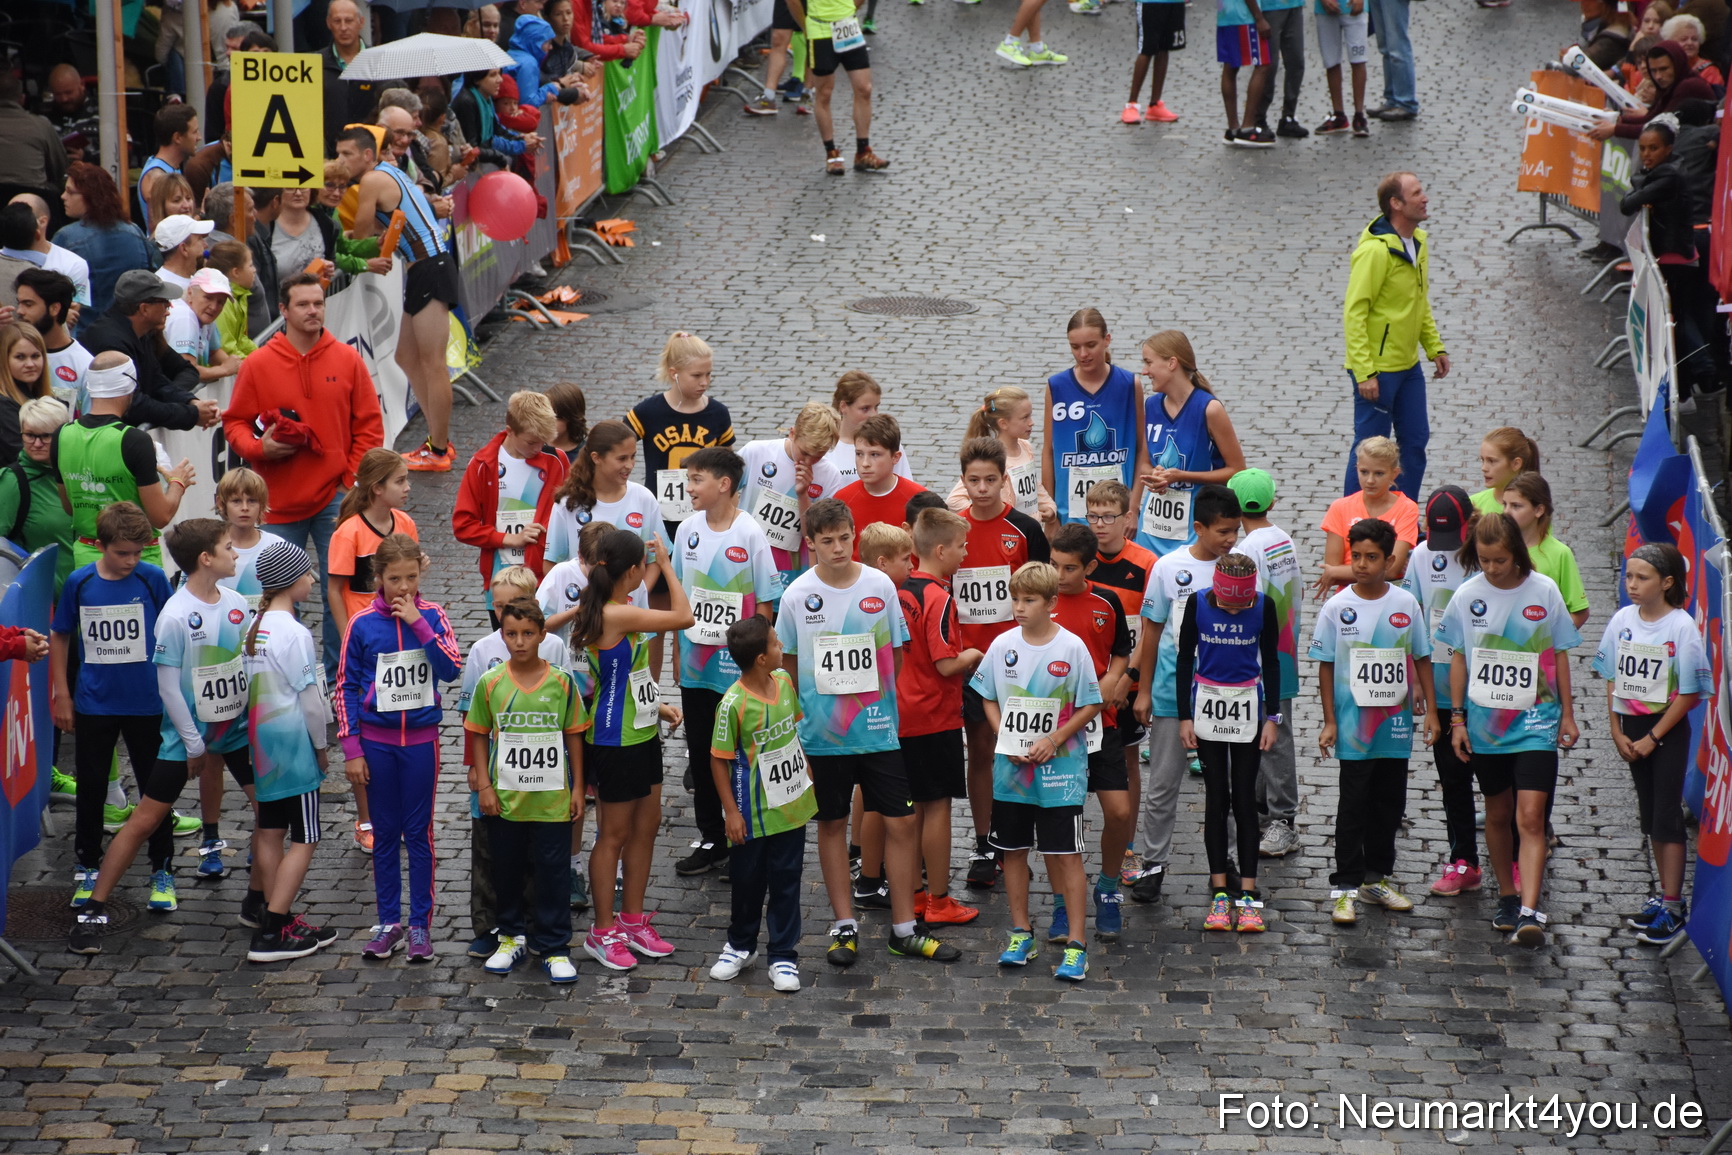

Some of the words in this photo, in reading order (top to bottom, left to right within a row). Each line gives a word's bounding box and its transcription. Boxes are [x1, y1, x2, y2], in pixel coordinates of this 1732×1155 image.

[243, 58, 313, 83] Block
[252, 94, 304, 158] A
[1052, 401, 1085, 421] 66
[1063, 449, 1127, 466] FIBALON
[759, 502, 801, 532] 4024
[1148, 497, 1184, 520] 4006
[766, 529, 785, 541] Felix
[1152, 521, 1171, 532] Louisa
[960, 580, 1007, 602] 4018
[693, 602, 736, 626] 4025
[970, 607, 997, 616] Marius
[88, 619, 139, 641] 4009
[701, 628, 720, 638] Frank
[1213, 624, 1227, 632] TV
[1230, 625, 1243, 633] 21
[1201, 633, 1256, 646] Büchenbach
[96, 646, 130, 656] Dominik
[821, 647, 872, 672] 4108
[382, 662, 428, 688] 4019
[1357, 662, 1404, 684] 4036
[1477, 663, 1532, 689] 4039
[1618, 654, 1663, 680] 4047
[202, 671, 247, 700] 4016
[1369, 690, 1396, 698] Yaman
[1623, 682, 1647, 693] Emma
[391, 692, 421, 703] Samina
[1491, 691, 1514, 702] Lucia
[214, 700, 243, 714] Jannick
[866, 706, 881, 716] 17.
[1202, 699, 1251, 721] 4041
[496, 711, 559, 728] BOCK
[717, 692, 739, 742] BOCK
[1005, 711, 1053, 734] 4046
[1392, 716, 1405, 726] 17.
[1212, 725, 1241, 735] Annika
[504, 746, 558, 769] 4049
[769, 749, 804, 785] 4048
[1041, 764, 1056, 775] 17.
[518, 775, 544, 784] Karim
